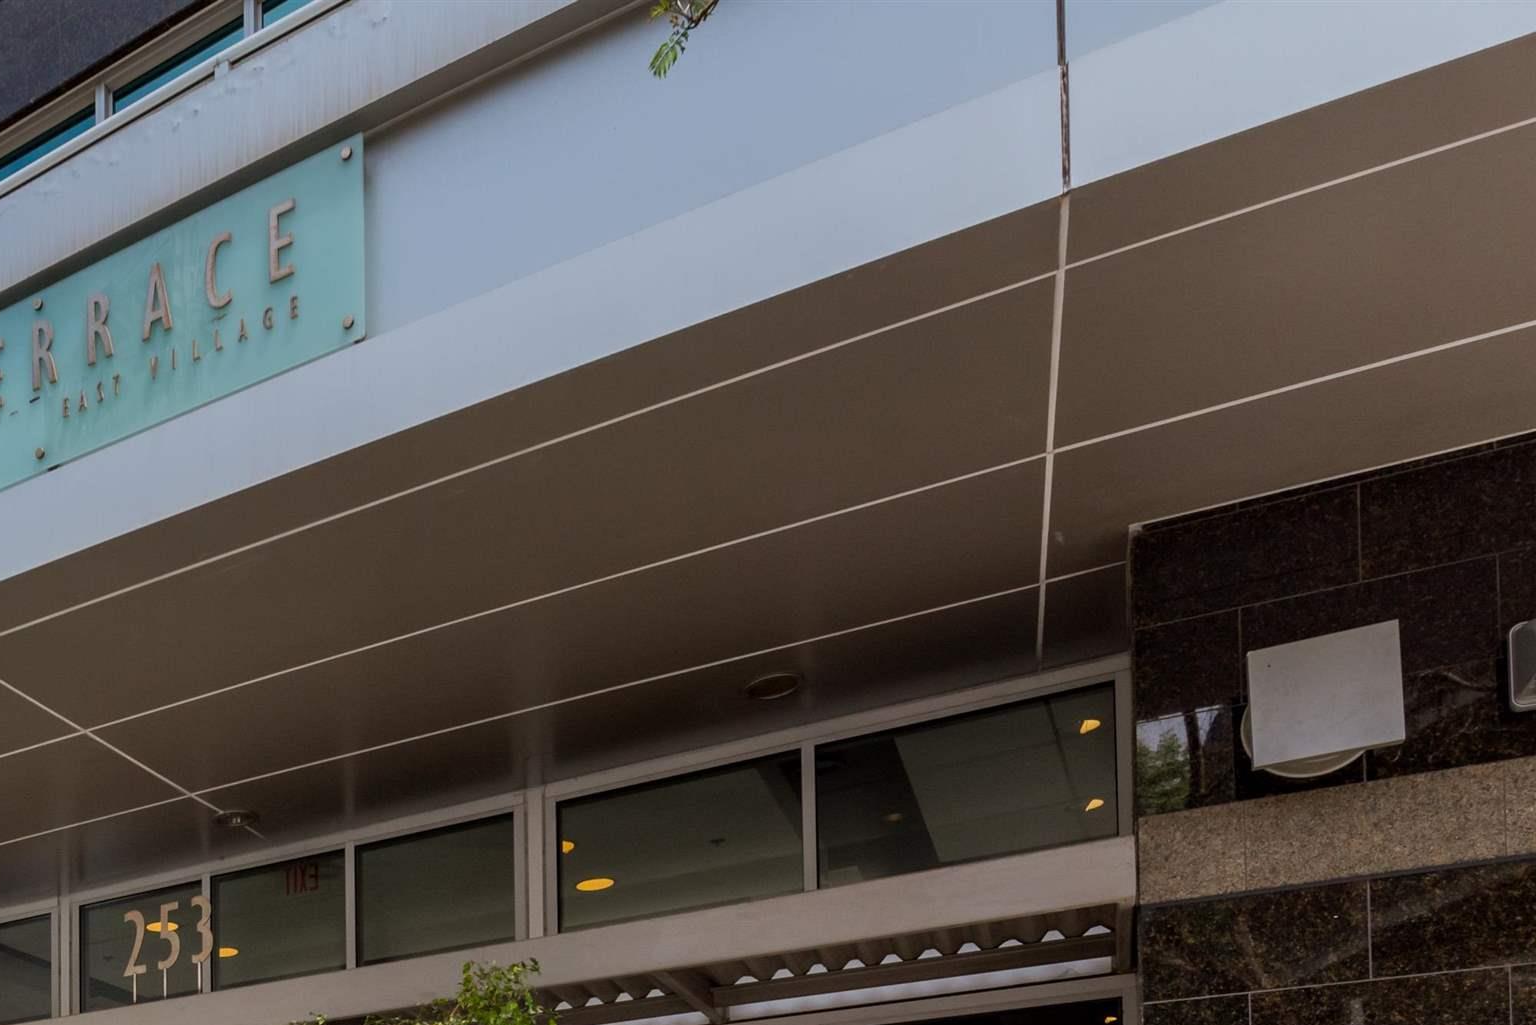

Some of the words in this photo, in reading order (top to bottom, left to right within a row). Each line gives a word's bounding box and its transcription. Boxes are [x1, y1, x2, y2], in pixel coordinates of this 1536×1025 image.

[63, 372, 121, 418] EAST
[149, 294, 300, 380] VILLAGE
[123, 895, 214, 977] 253
